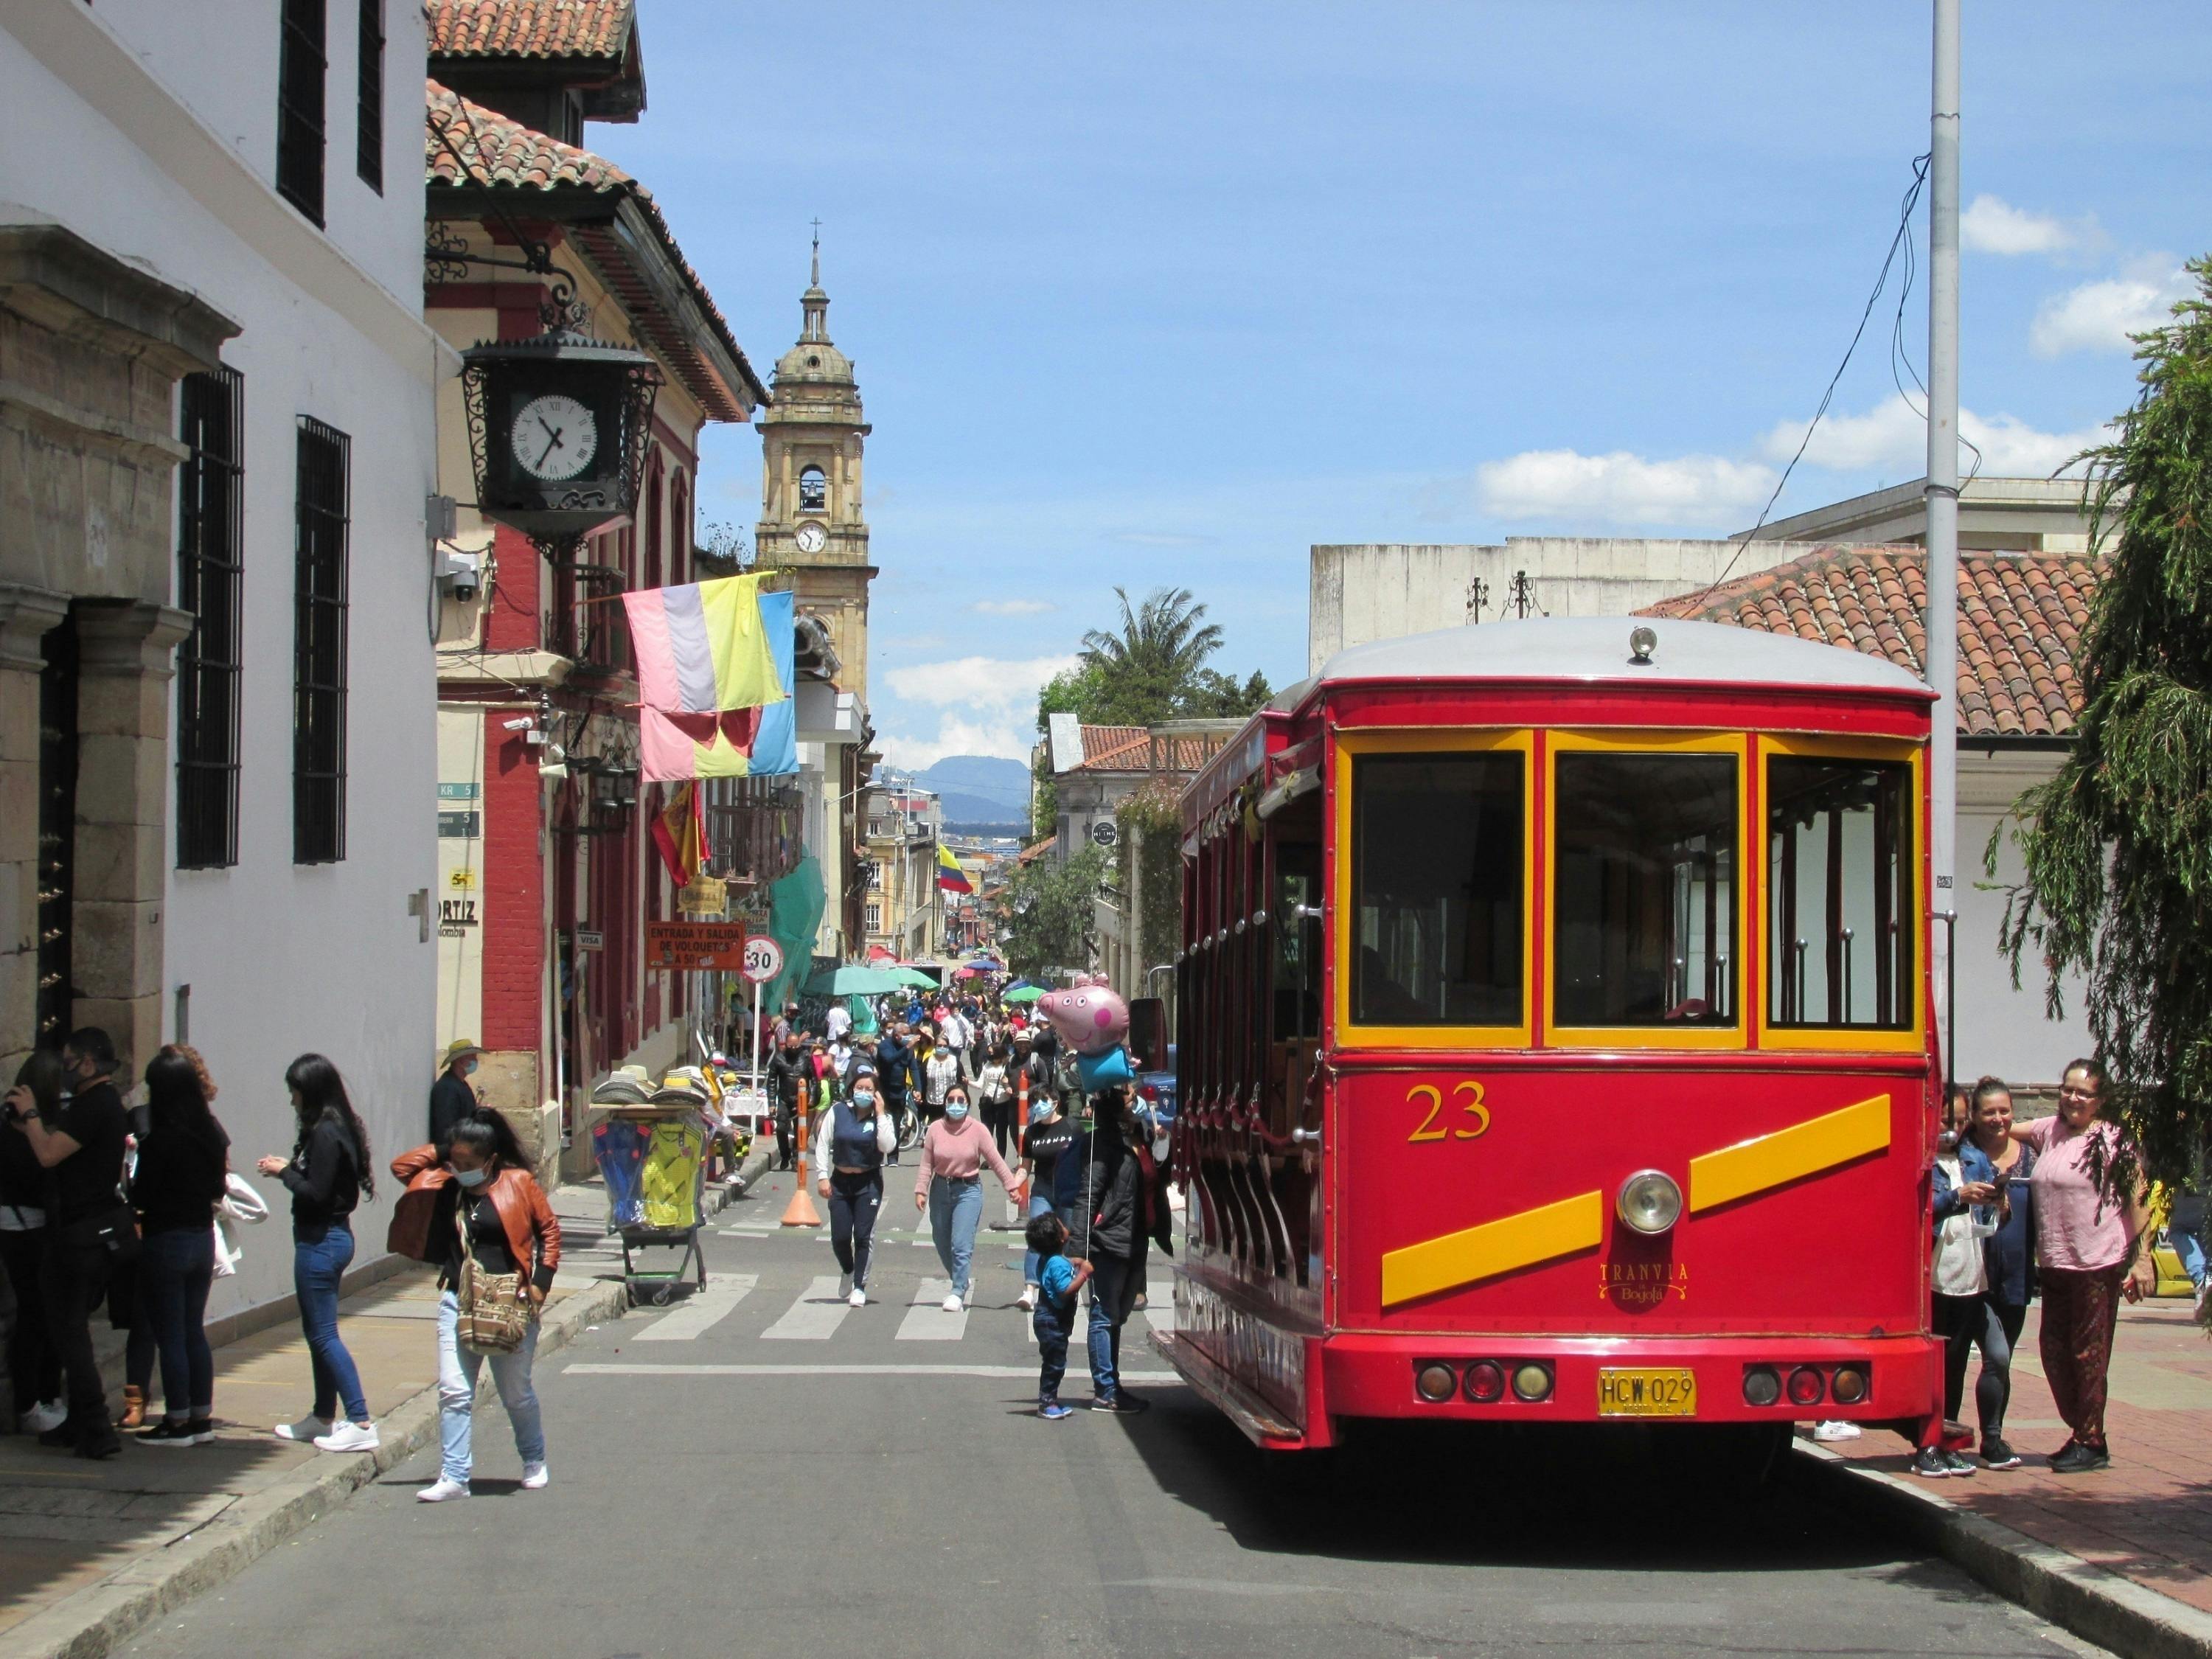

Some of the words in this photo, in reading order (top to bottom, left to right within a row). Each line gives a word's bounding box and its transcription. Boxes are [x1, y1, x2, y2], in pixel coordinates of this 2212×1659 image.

[440, 785, 453, 796] KR
[465, 785, 472, 796] 5
[464, 813, 470, 824] 5
[651, 928, 693, 939] ENTRADA
[697, 928, 703, 938] Y
[707, 929, 740, 939] SALIDA
[660, 941, 672, 951] DE
[751, 951, 771, 969] 30
[1406, 1081, 1490, 1141] 23
[1600, 1263, 1688, 1280] TRANVIA
[1622, 1286, 1663, 1303] Bogotá
